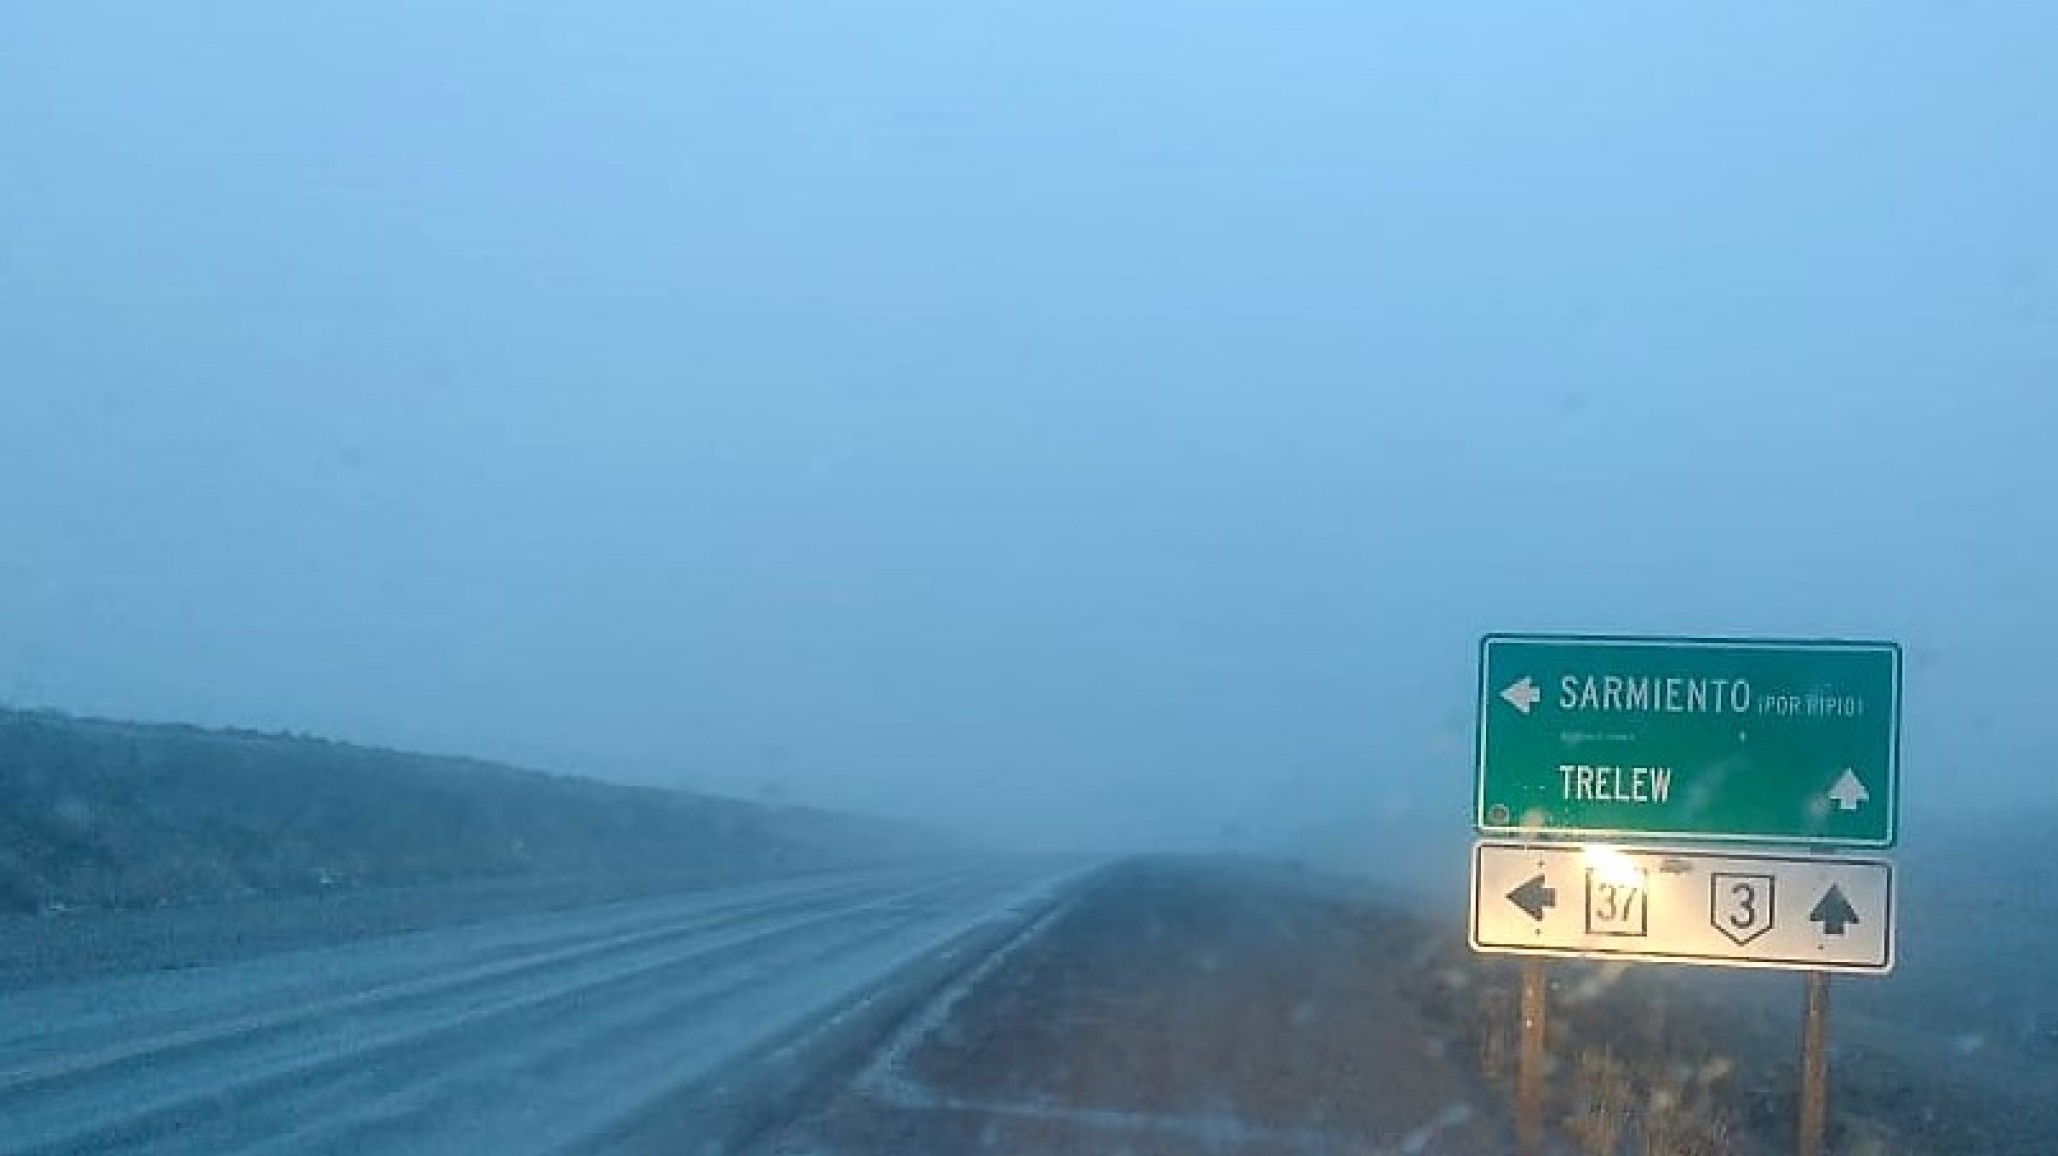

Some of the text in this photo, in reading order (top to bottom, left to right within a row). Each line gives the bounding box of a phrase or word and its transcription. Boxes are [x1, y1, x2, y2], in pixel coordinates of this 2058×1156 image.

[1559, 675, 1751, 713] SARMIENTO
[1559, 764, 1672, 804] TRELEW
[1596, 882, 1639, 922] 37
[1729, 882, 1756, 930] 3
